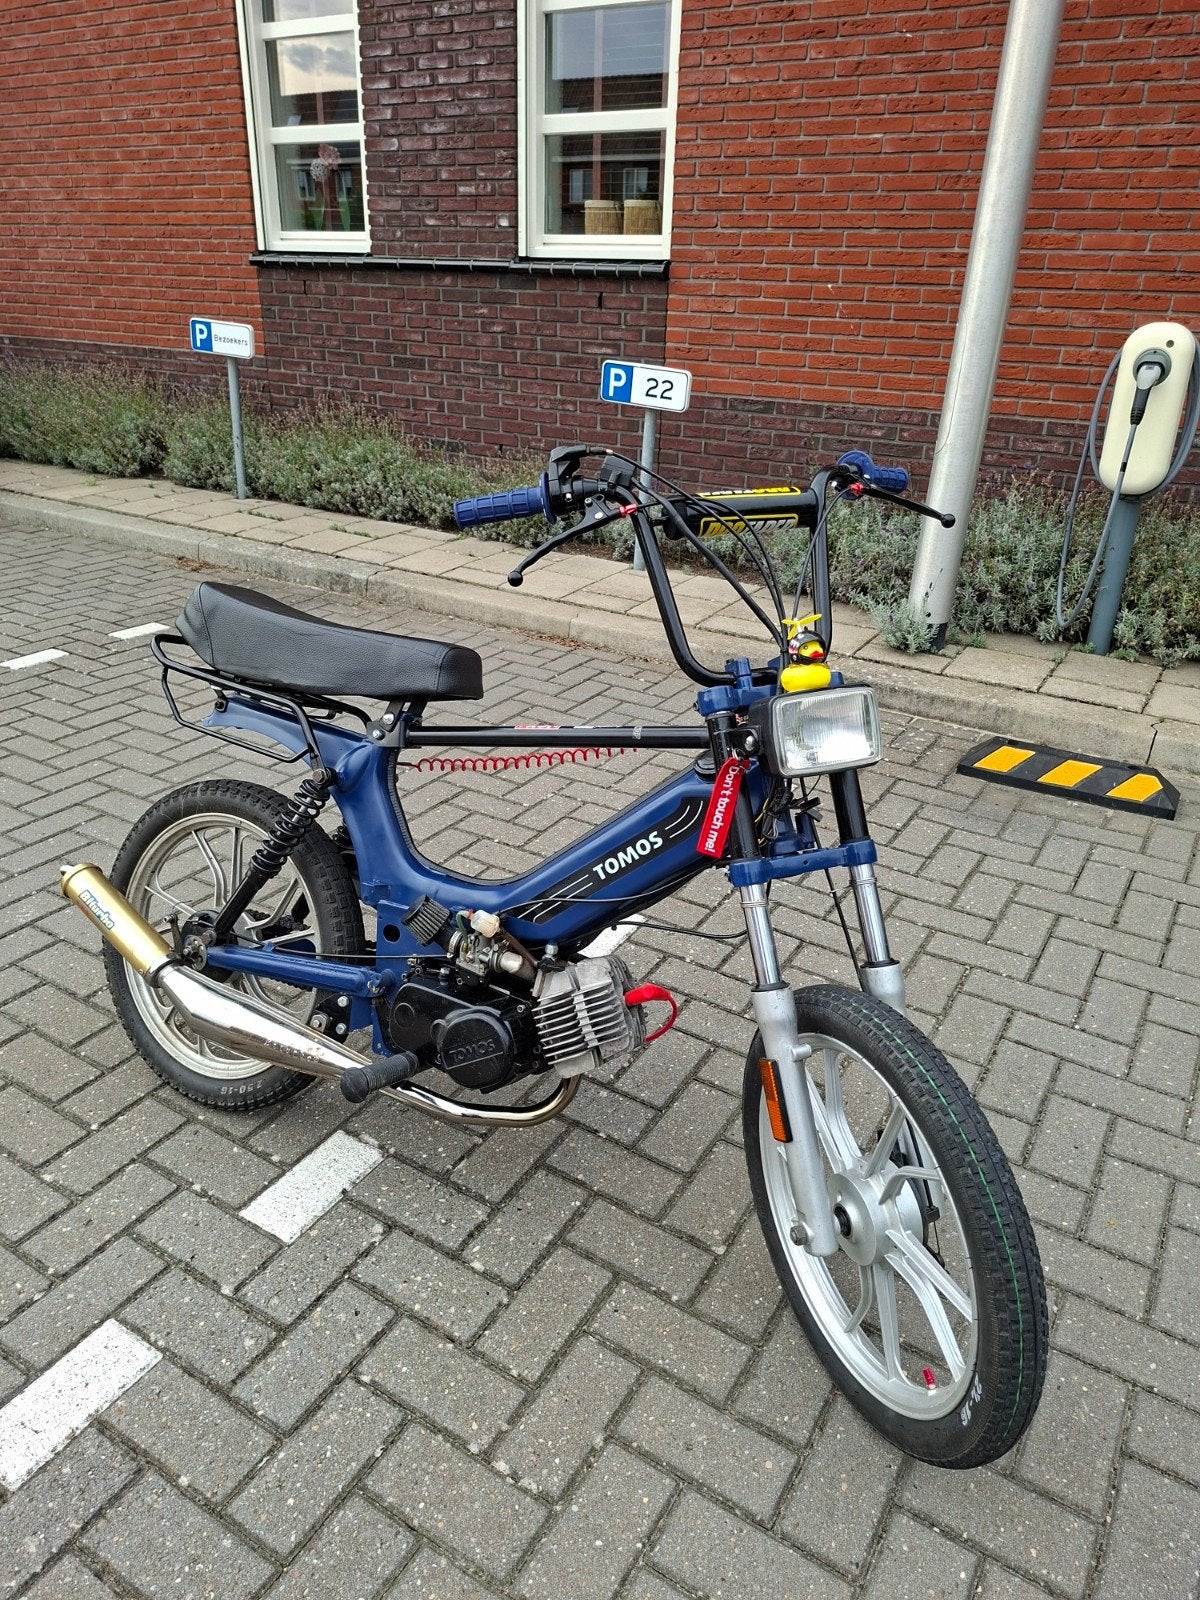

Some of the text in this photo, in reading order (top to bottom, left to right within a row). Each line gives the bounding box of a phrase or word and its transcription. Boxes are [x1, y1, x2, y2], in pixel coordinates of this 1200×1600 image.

[195, 323, 248, 348] P Bezoekers
[608, 367, 674, 401] P 22
[710, 797, 730, 829] touch
[592, 830, 663, 880] TOMOS
[704, 831, 719, 853] me!
[448, 1038, 496, 1063] TOMOS
